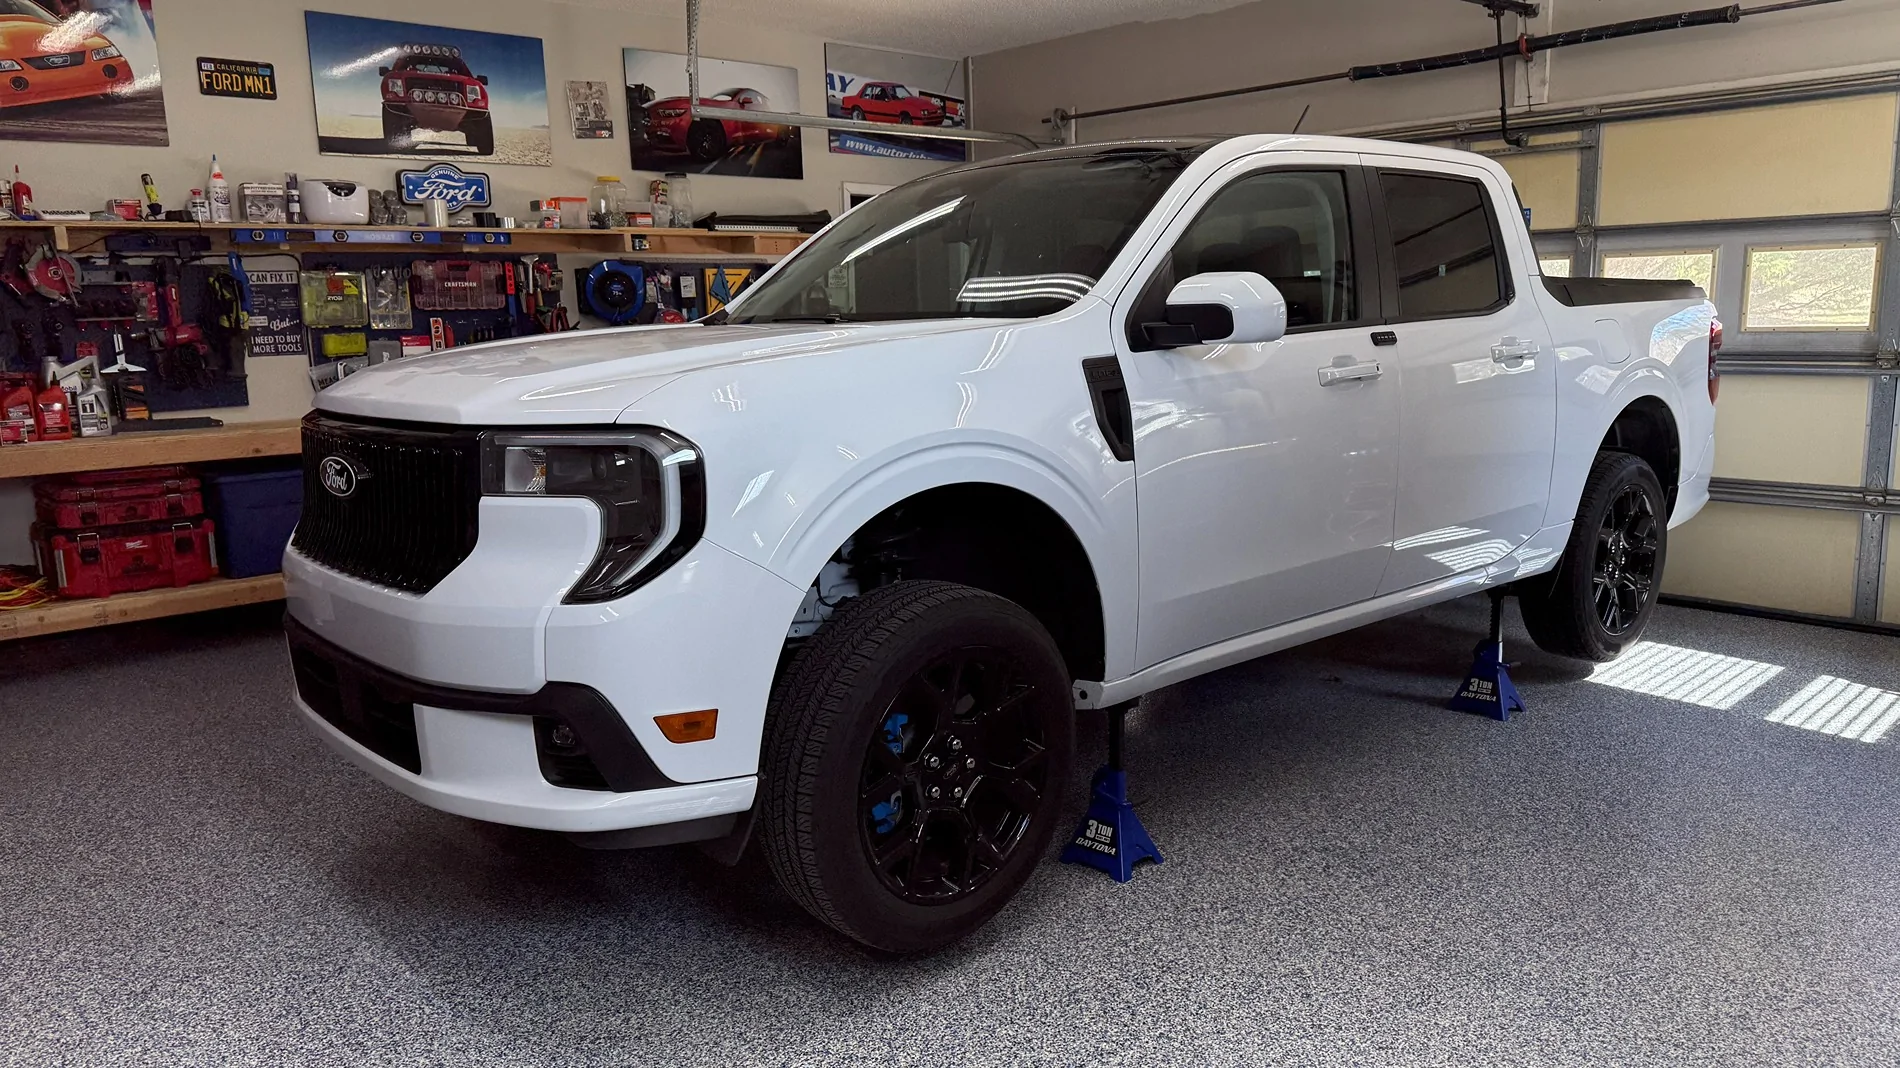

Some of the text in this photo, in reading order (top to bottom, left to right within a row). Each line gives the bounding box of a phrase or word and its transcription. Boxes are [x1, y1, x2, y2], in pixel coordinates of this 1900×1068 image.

[216, 64, 257, 73] CALIFORNIA
[202, 71, 273, 95] FORD MN1
[430, 169, 460, 180] GENUINE
[414, 179, 477, 201] Ford
[249, 273, 294, 283] CAN FIX IT
[255, 336, 274, 344] NEED
[275, 335, 285, 343] TO
[287, 334, 301, 343] BUY
[253, 343, 302, 353] MORE TOOLS
[326, 461, 347, 491] Ford
[1469, 678, 1479, 691] 3
[1480, 681, 1492, 689] TON
[1460, 691, 1497, 701] DAYTONA
[1086, 819, 1113, 838] 3 TON
[1075, 837, 1116, 855] DAYTONA
